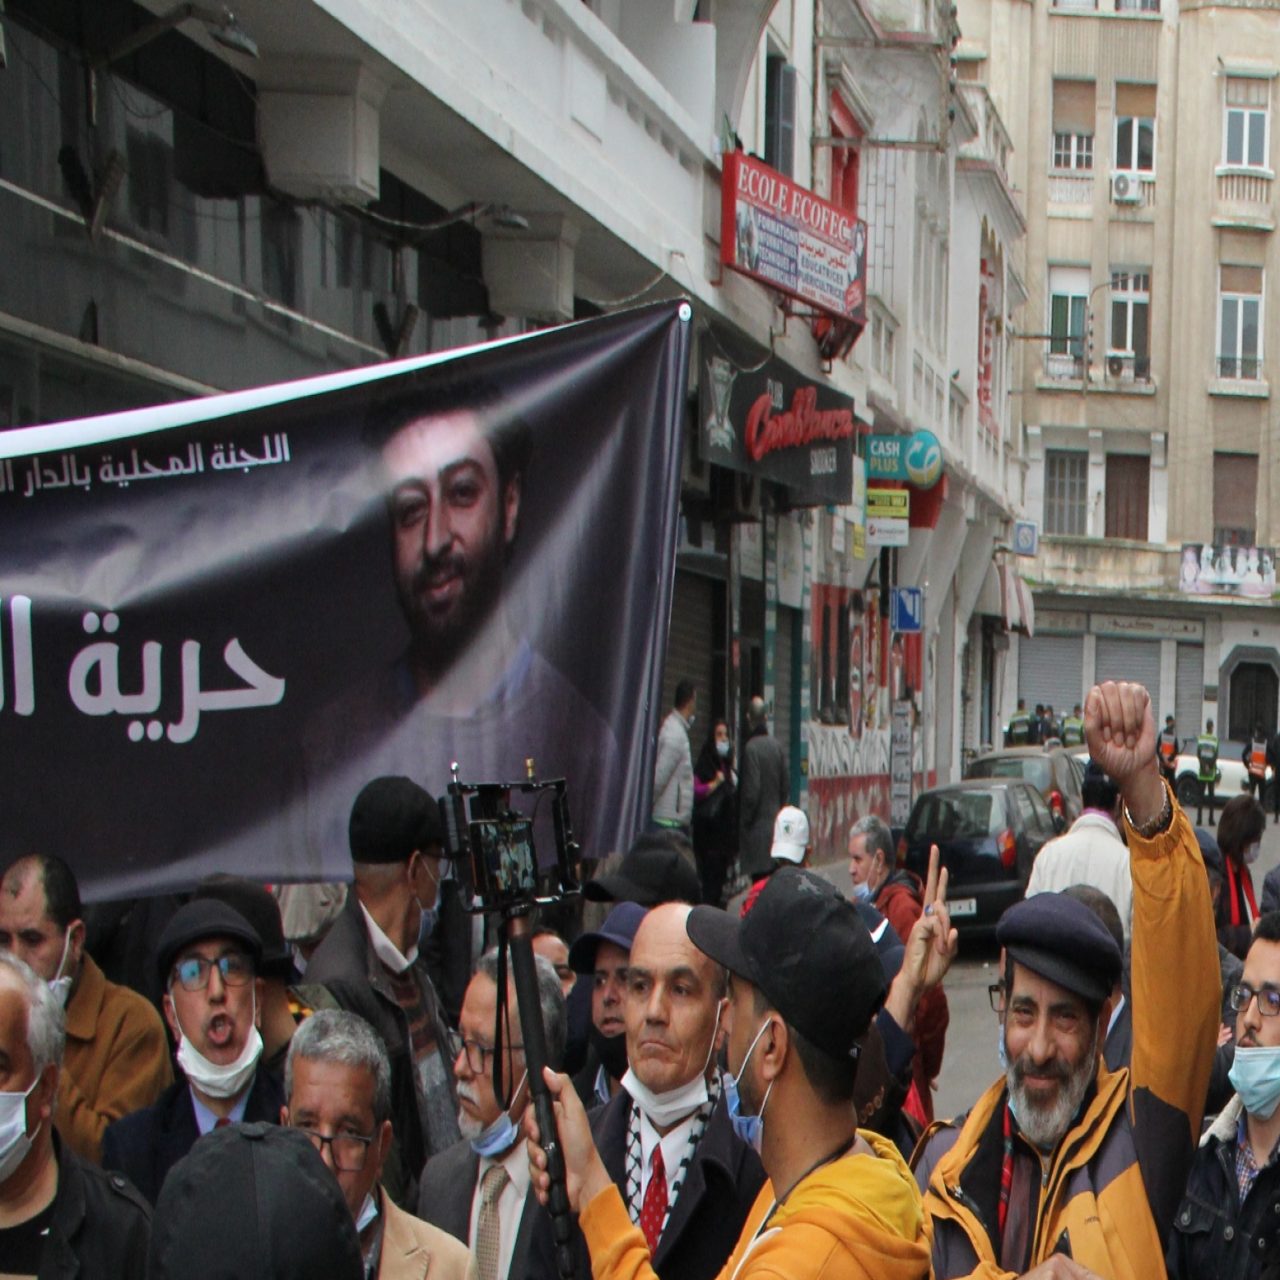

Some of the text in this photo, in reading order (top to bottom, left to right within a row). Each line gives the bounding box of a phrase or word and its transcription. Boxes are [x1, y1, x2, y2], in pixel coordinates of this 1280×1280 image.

[738, 162, 849, 244] ECOLE ECOFEC
[99, 442, 205, 488] المحلية
[210, 432, 291, 473] اللجنة
[870, 440, 900, 456] CASH
[870, 458, 899, 472] PLUS
[24, 454, 92, 497] بالدار
[68, 611, 286, 744] حرية
